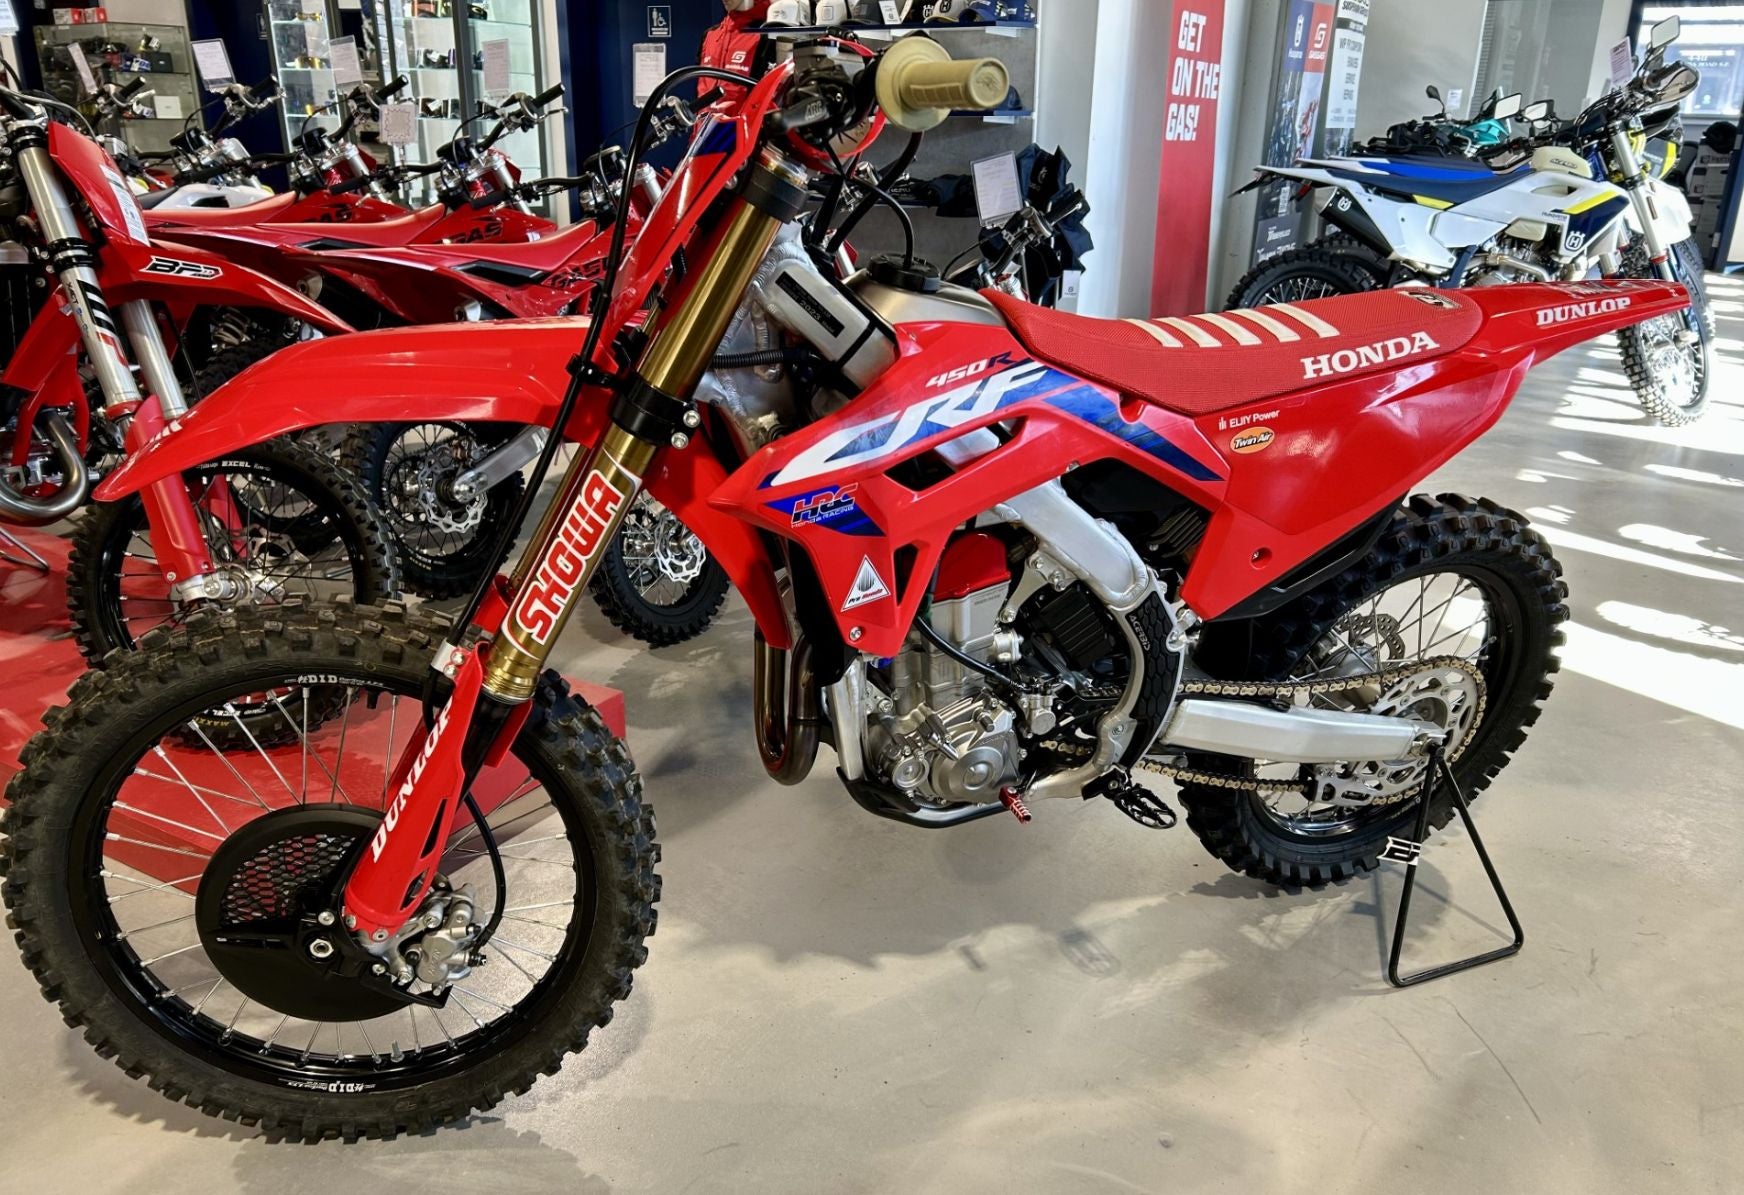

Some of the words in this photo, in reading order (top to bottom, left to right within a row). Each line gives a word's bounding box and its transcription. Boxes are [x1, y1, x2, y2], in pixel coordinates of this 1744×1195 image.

[1178, 10, 1207, 53] GET
[1171, 57, 1194, 97] ON
[1195, 60, 1220, 99] THE
[1165, 103, 1200, 141] GAS!
[1536, 297, 1631, 326] DUNLOP
[925, 351, 1020, 388] 450R
[1301, 331, 1440, 379] HONDA
[770, 359, 1048, 486] CRF
[1252, 410, 1280, 423] Power
[1234, 436, 1258, 449] Twin
[1257, 431, 1273, 443] Air
[221, 460, 252, 468] EXCEL
[791, 482, 858, 524] HRC
[822, 504, 855, 519] RACING
[515, 469, 625, 645] SHOWA
[371, 695, 453, 863] DUNLOP
